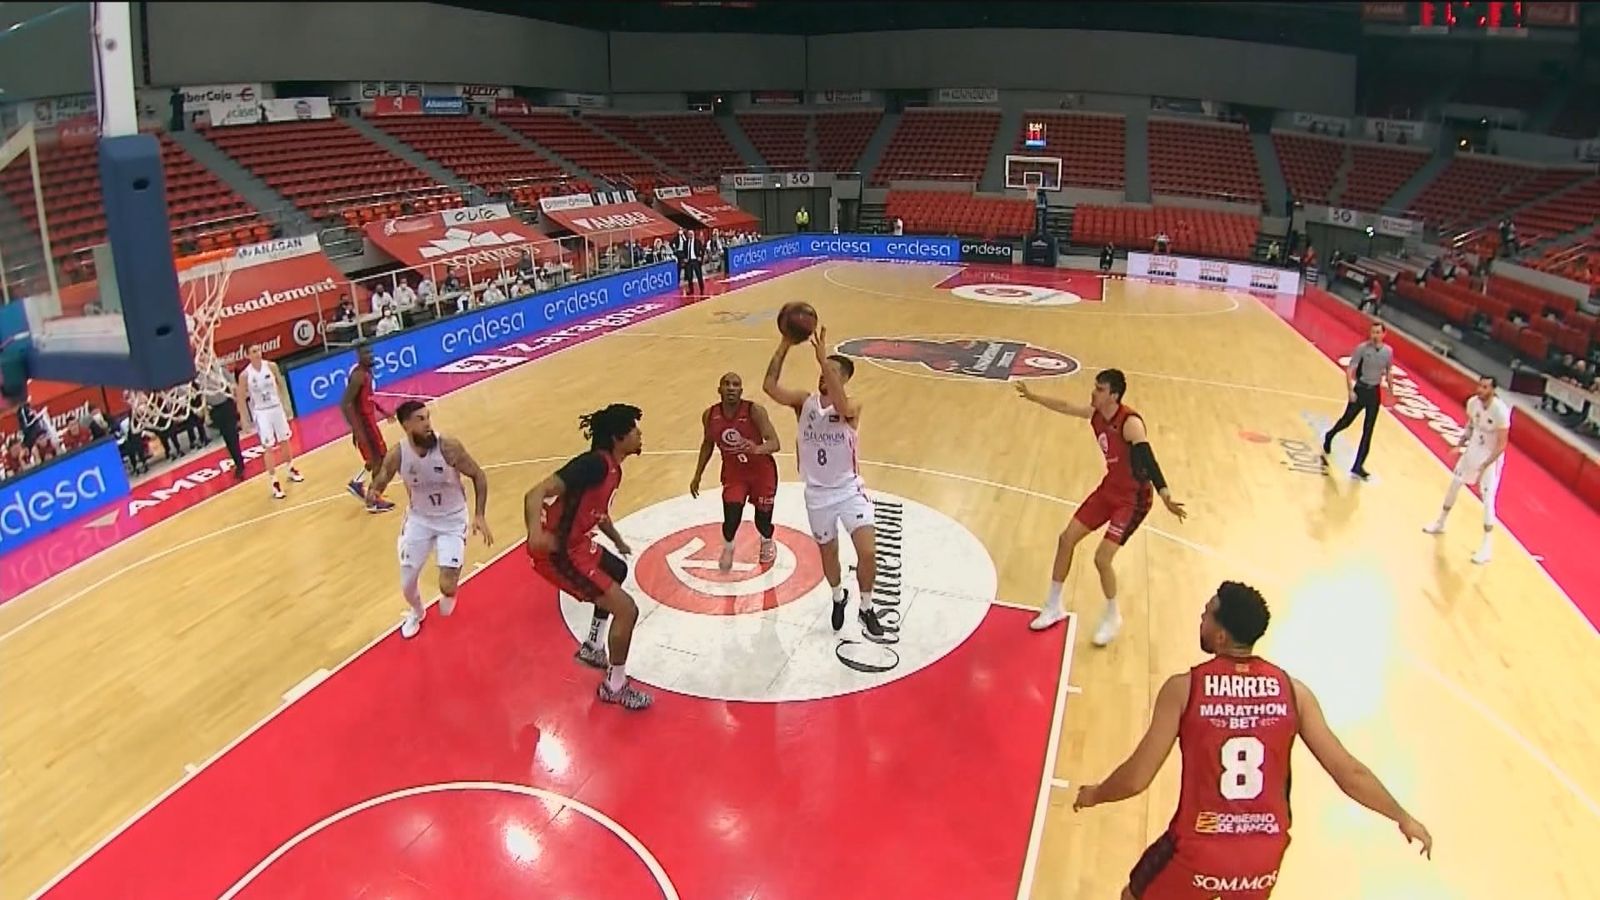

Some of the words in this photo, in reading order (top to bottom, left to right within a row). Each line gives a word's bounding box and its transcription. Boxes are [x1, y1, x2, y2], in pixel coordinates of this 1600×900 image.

[809, 237, 870, 254] endesa
[886, 240, 951, 258] endesa
[961, 243, 1011, 256] endesa
[733, 248, 767, 268] endesa
[622, 269, 674, 300] endesa
[543, 287, 610, 322] endesa
[441, 310, 526, 354] endesa
[309, 343, 419, 400] enesa
[817, 448, 828, 467] 8
[0, 465, 107, 543] desa
[428, 492, 442, 507] 17
[1204, 674, 1281, 698] HARRIS
[1200, 702, 1287, 717] MARATHON
[1229, 716, 1260, 730] BET
[1220, 737, 1265, 800] 8
